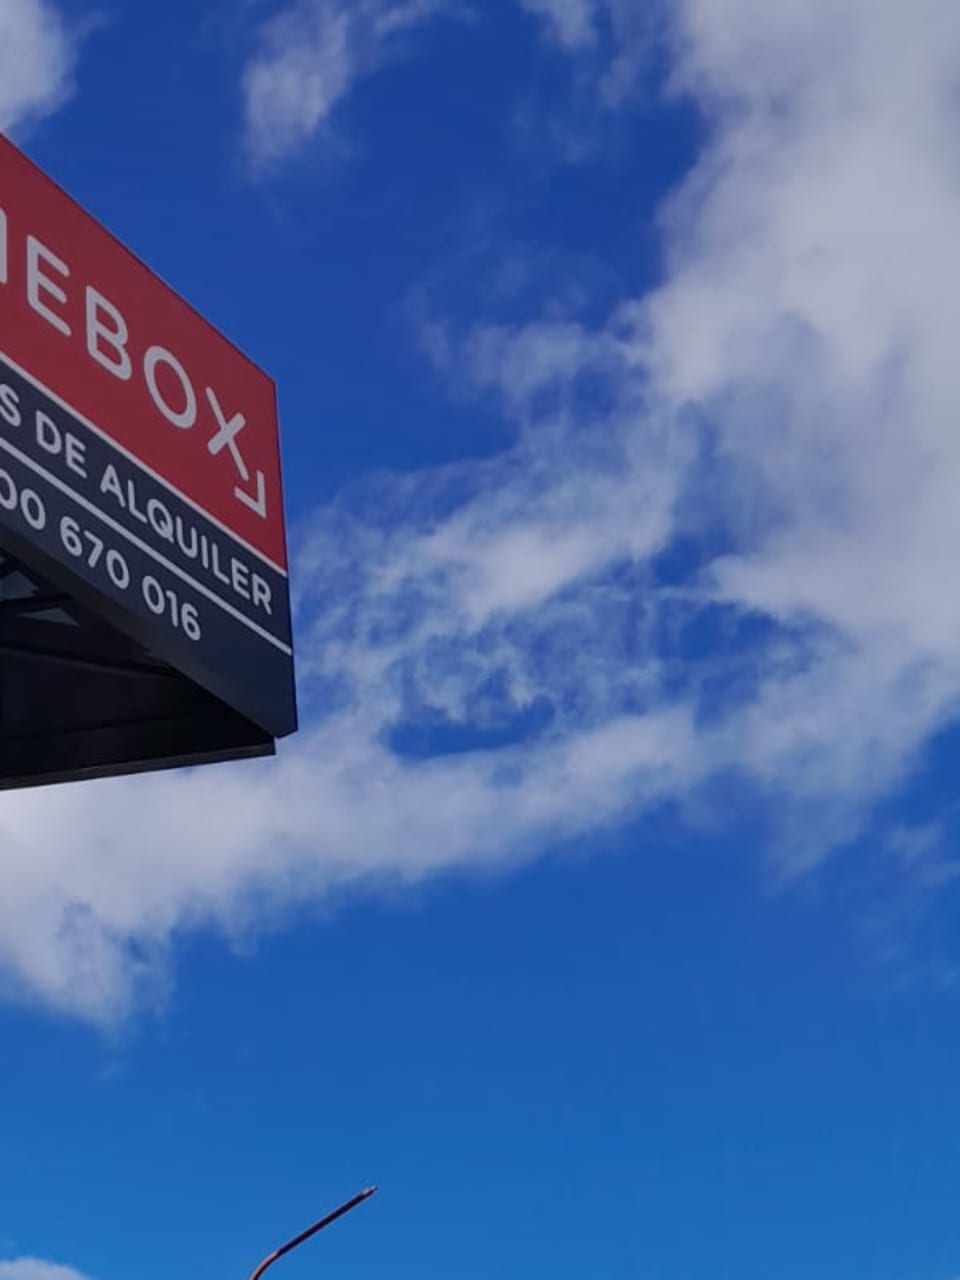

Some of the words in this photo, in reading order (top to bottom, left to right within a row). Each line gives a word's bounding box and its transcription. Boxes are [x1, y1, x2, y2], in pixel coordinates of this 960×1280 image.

[36, 411, 87, 479] DE
[101, 465, 272, 614] ALQUILER
[60, 517, 130, 590] 670
[142, 575, 201, 641] 016
